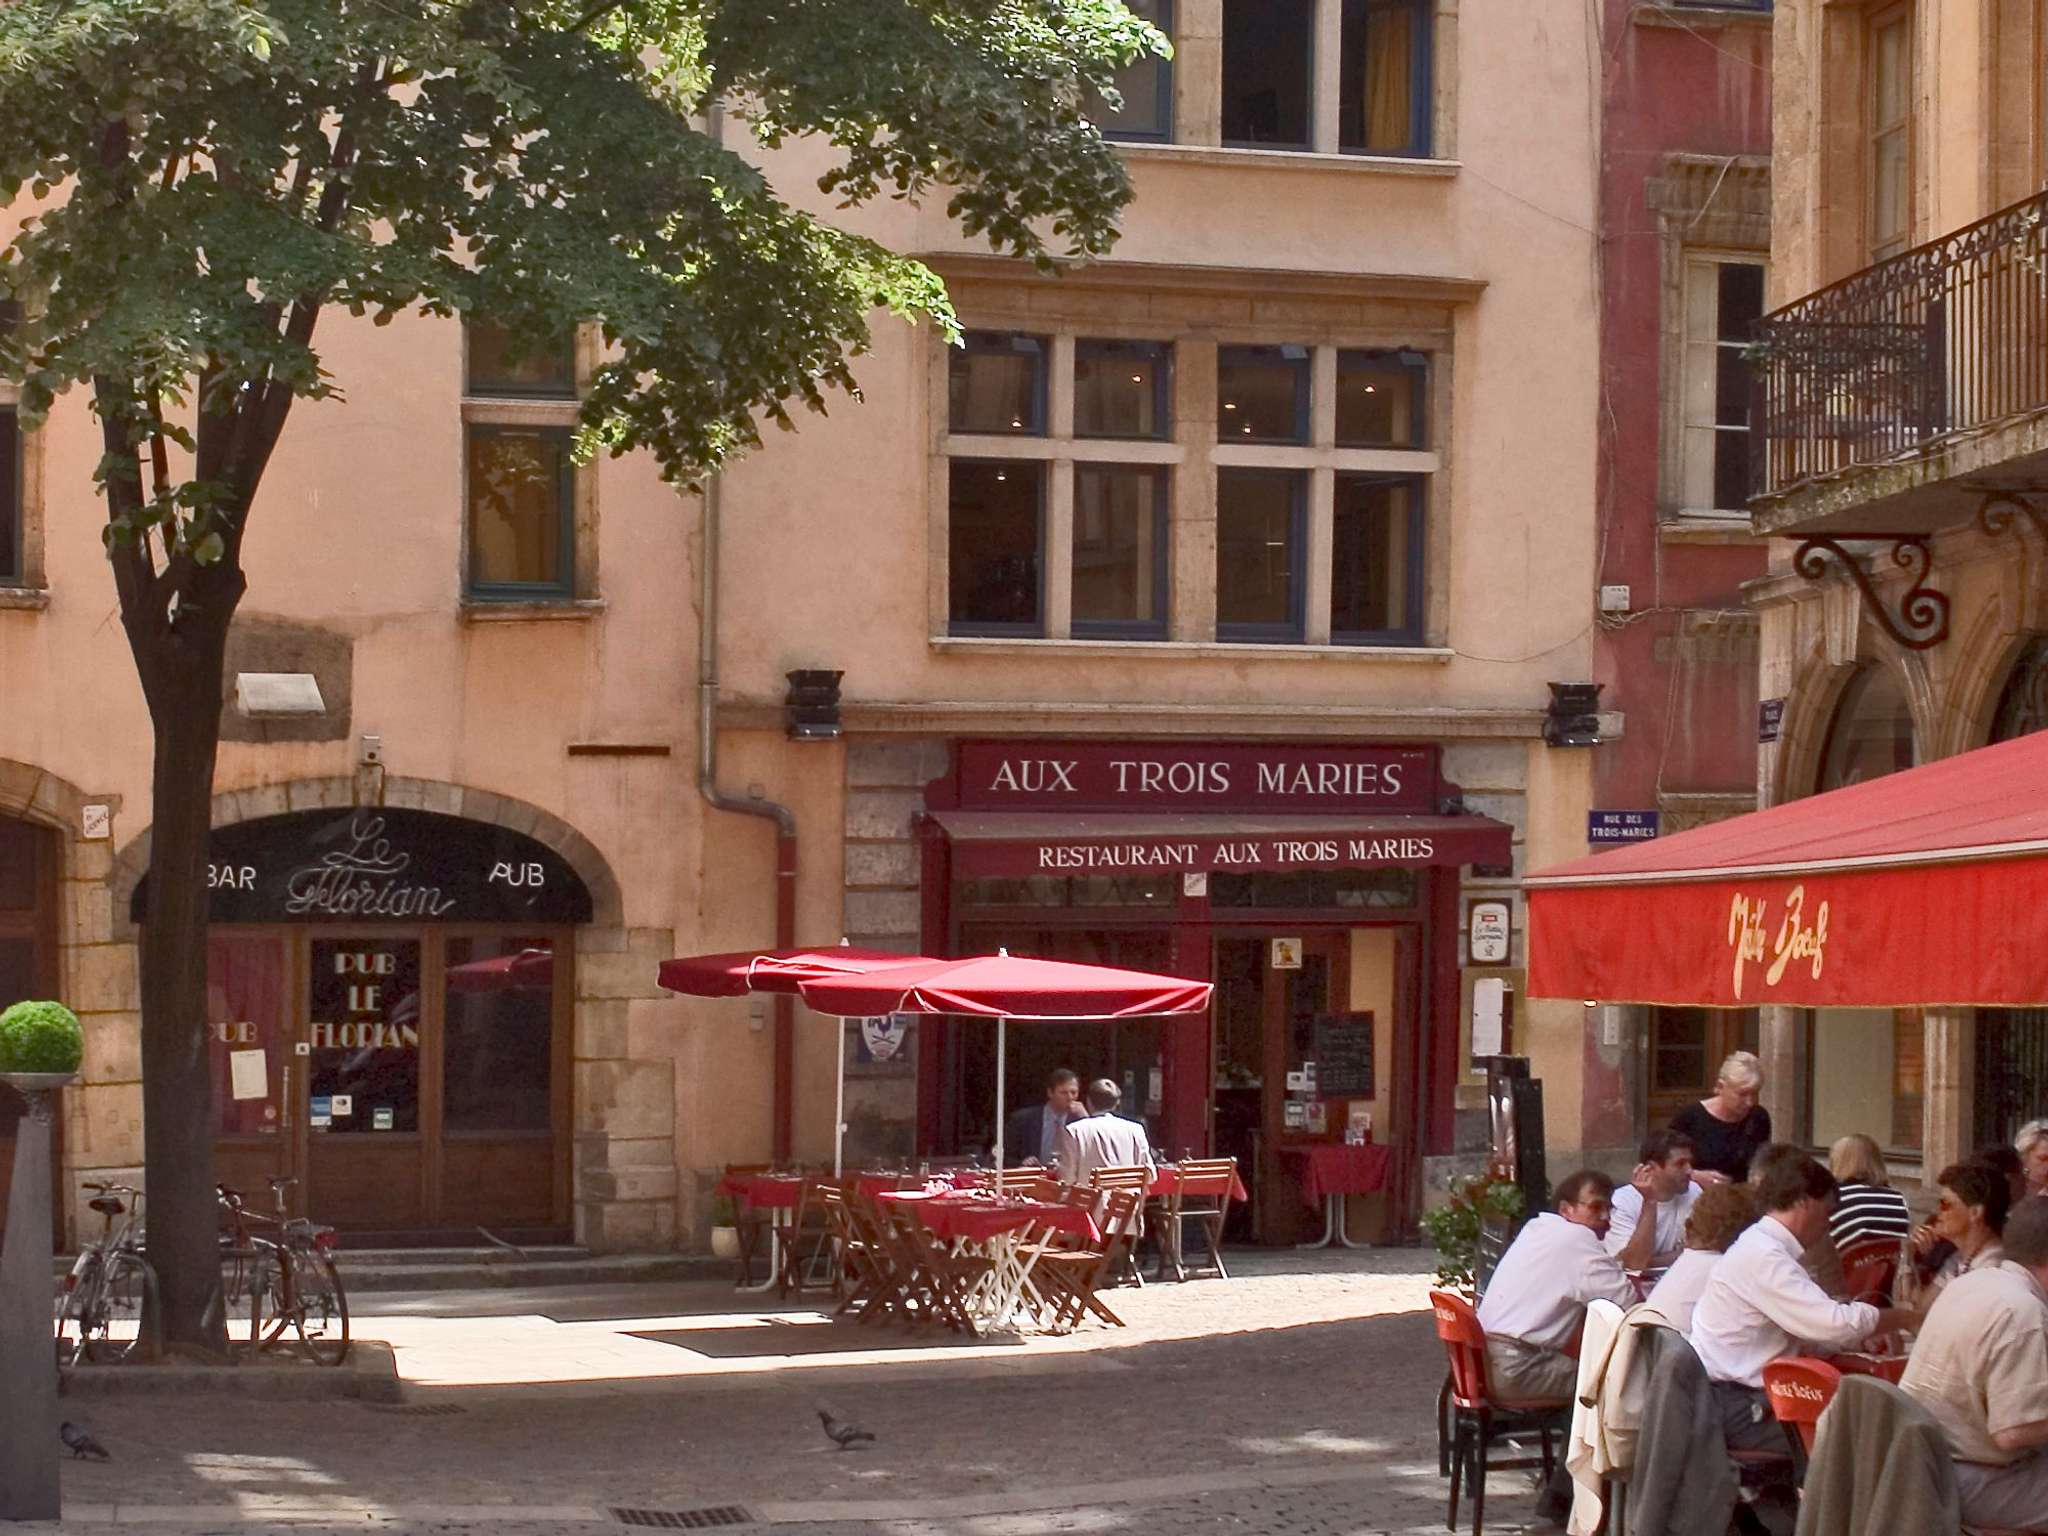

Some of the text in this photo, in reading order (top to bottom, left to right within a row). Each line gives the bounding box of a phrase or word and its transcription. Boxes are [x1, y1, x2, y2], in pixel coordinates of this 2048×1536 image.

[989, 760, 1403, 795] AUX TROIS MARIES
[1603, 815, 1642, 824] RUE DES
[1039, 838, 1434, 868] RESTAURANT AUX TROIS MARIES
[207, 863, 257, 891] BAR
[489, 862, 545, 887] PUB
[334, 952, 396, 974] PUB
[350, 985, 382, 1011] LE
[310, 1022, 420, 1048] FLORIAN
